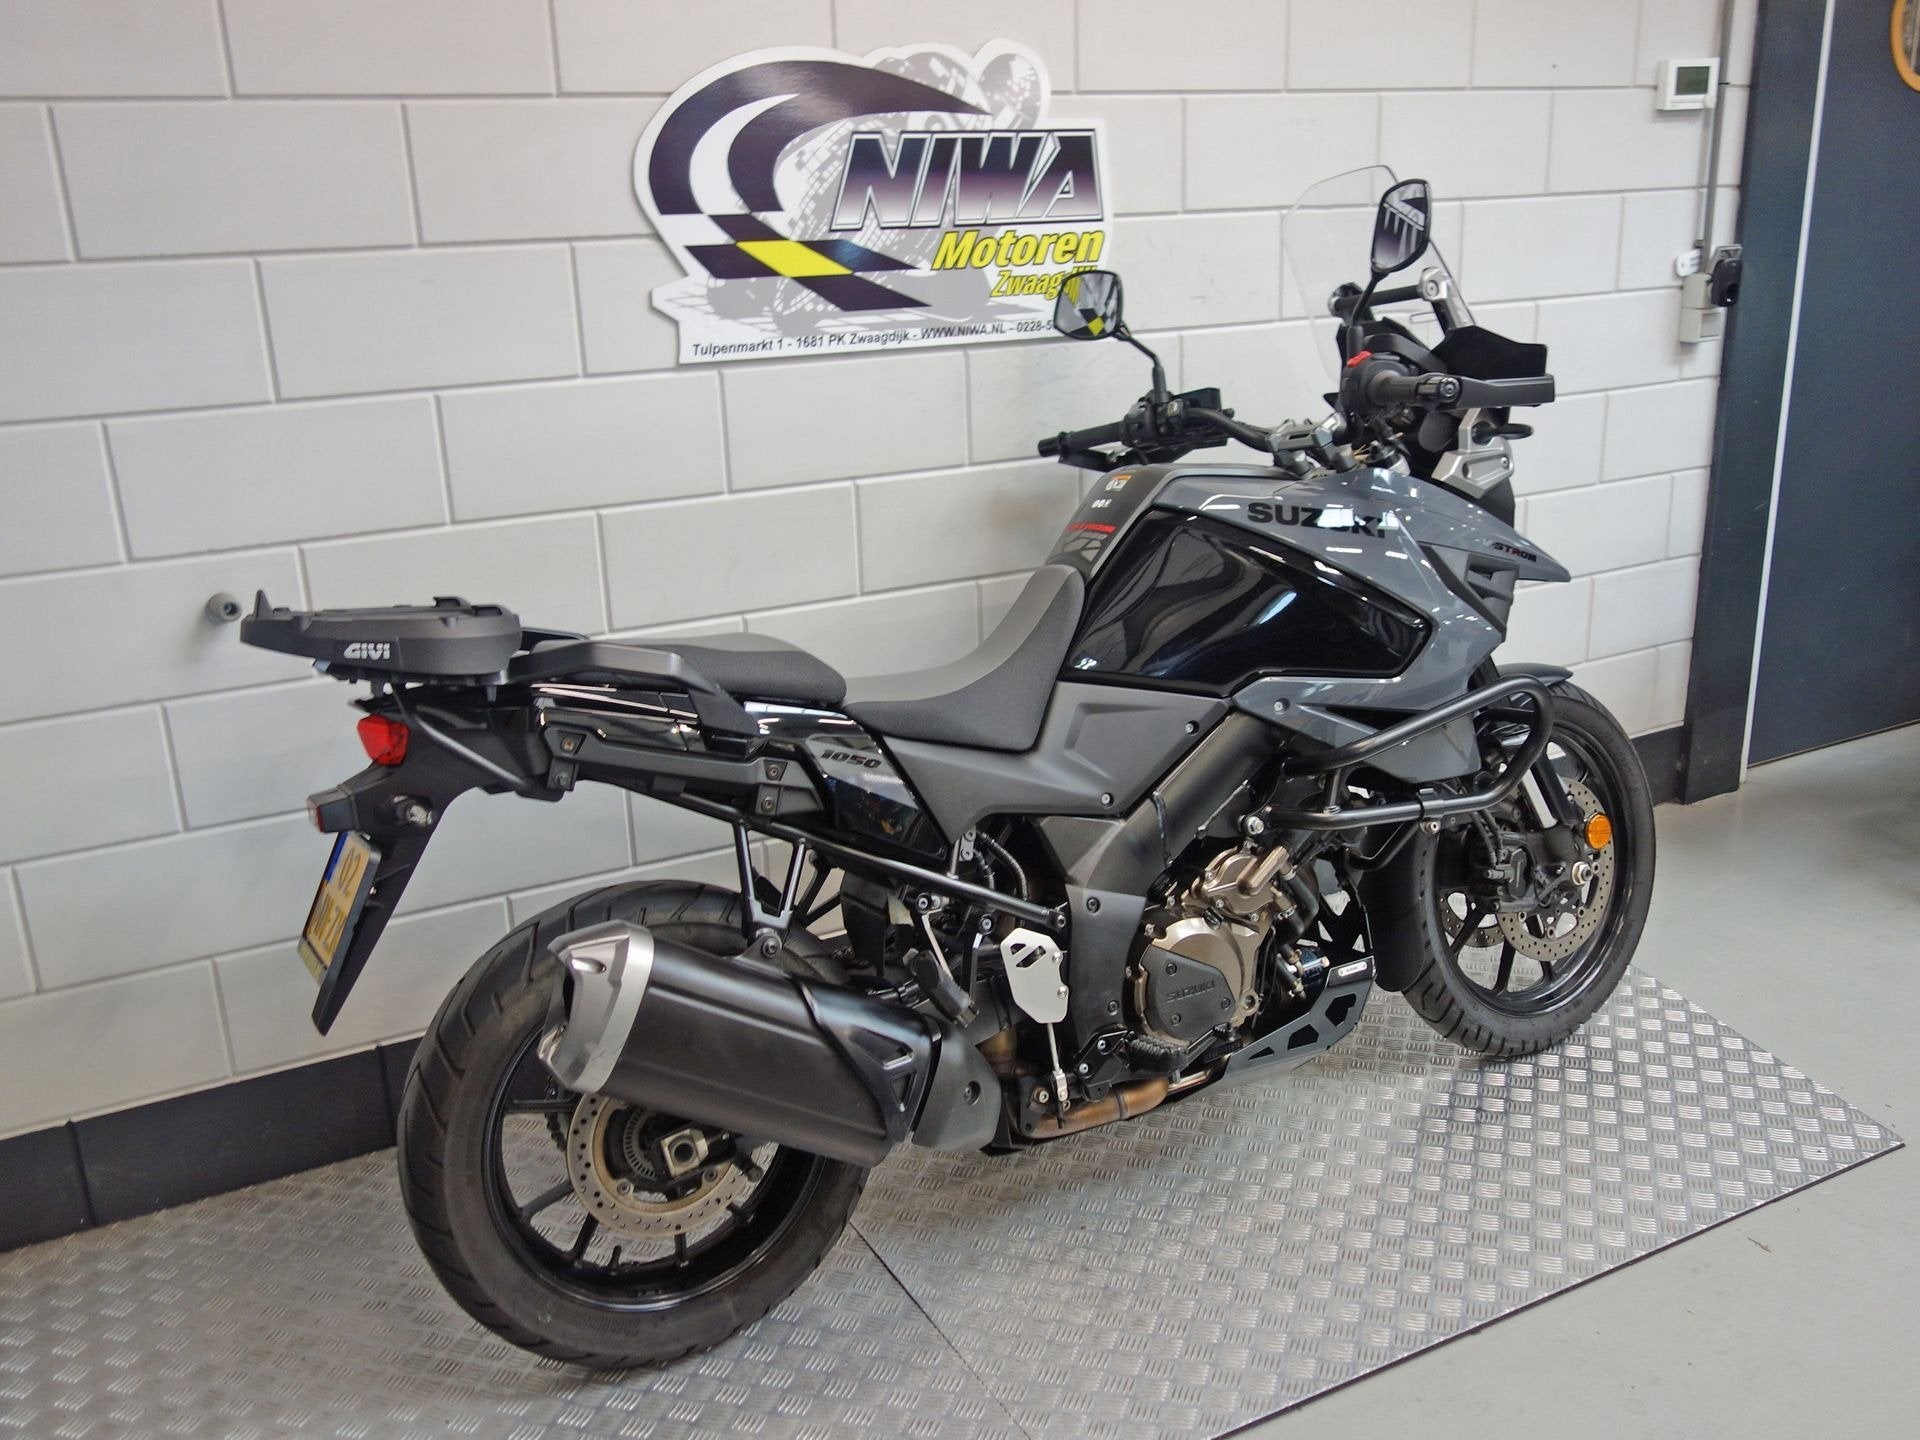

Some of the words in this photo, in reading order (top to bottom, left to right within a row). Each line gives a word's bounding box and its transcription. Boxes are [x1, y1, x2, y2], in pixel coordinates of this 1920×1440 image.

[829, 128, 1104, 233] NIWA
[930, 229, 1105, 271] Motoren
[692, 339, 773, 358] Tulpenmarkt
[777, 339, 784, 350] 1
[797, 336, 823, 348] 1681
[828, 334, 846, 345] PK
[850, 329, 910, 346] Zwaagdijk
[920, 323, 1006, 340] WWW.NIWA.NL
[343, 642, 391, 660] GIVI
[821, 749, 882, 769] 1050
